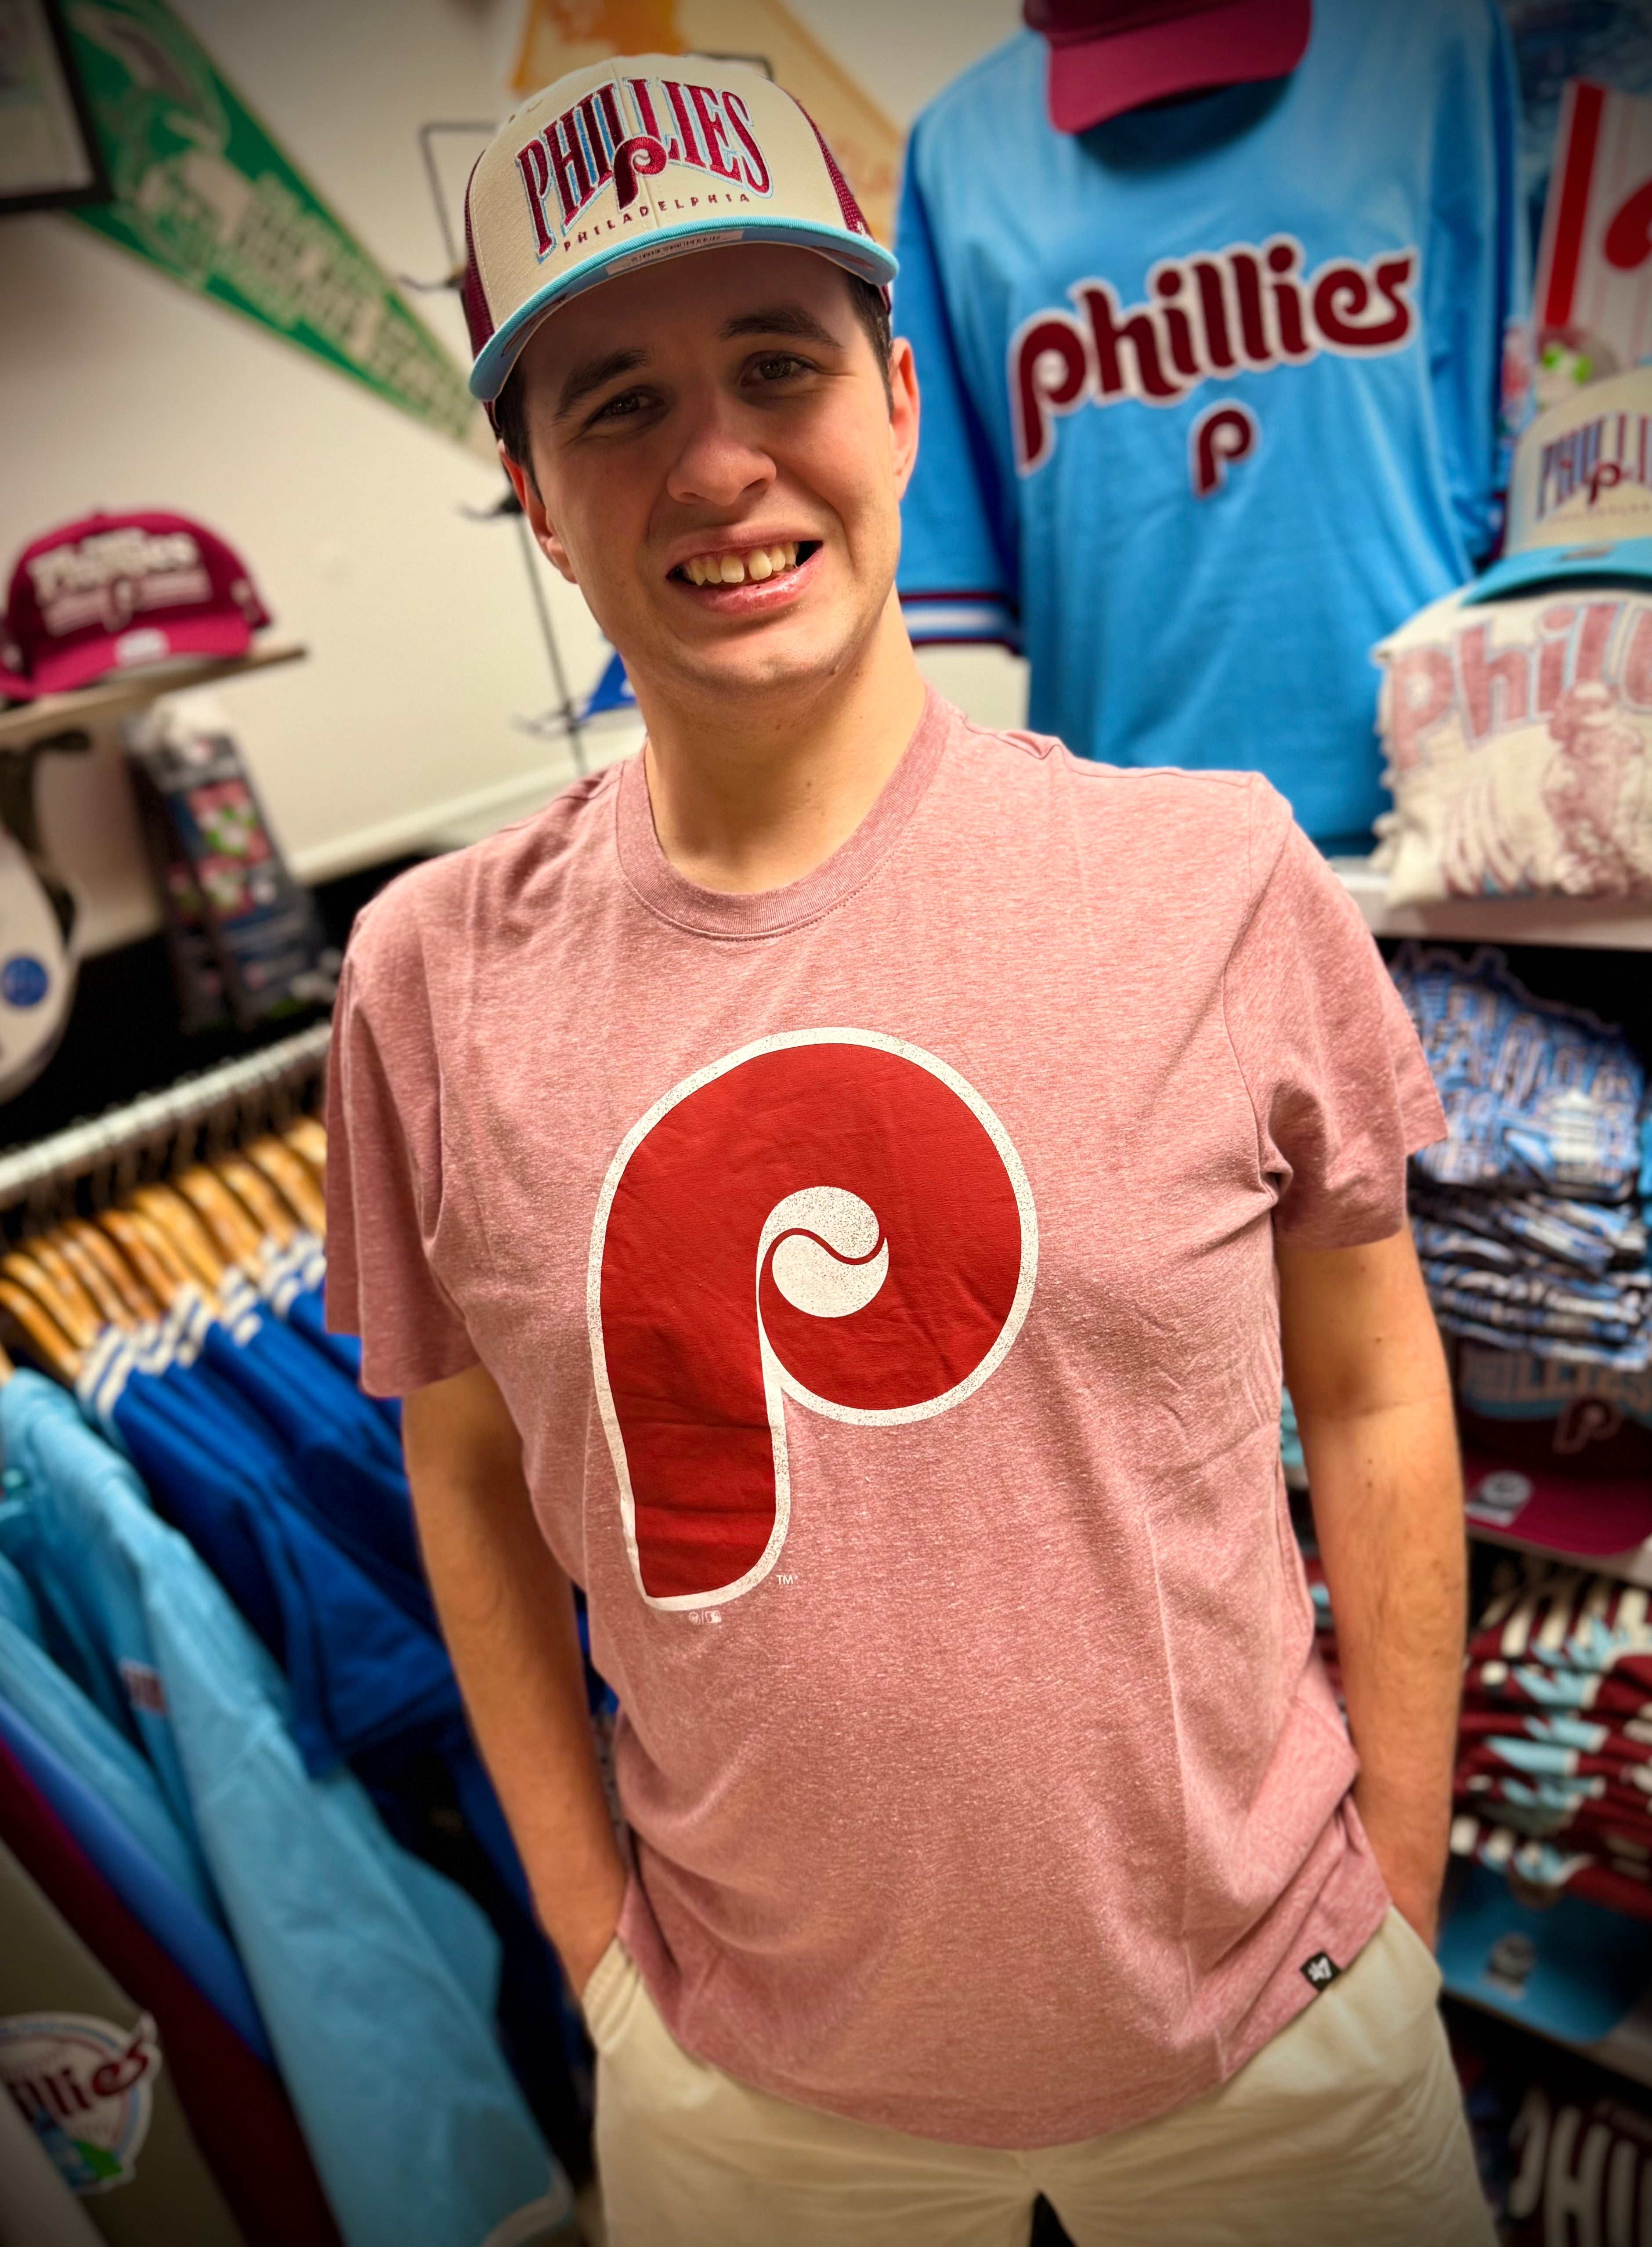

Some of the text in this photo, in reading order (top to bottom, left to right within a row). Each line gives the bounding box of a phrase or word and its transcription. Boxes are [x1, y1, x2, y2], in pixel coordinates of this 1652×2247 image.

[515, 78, 773, 262] PHILLIES
[563, 193, 750, 252] PHILADELPHIA
[587, 1027, 1038, 1611] P
[776, 1574, 794, 1585] TM
